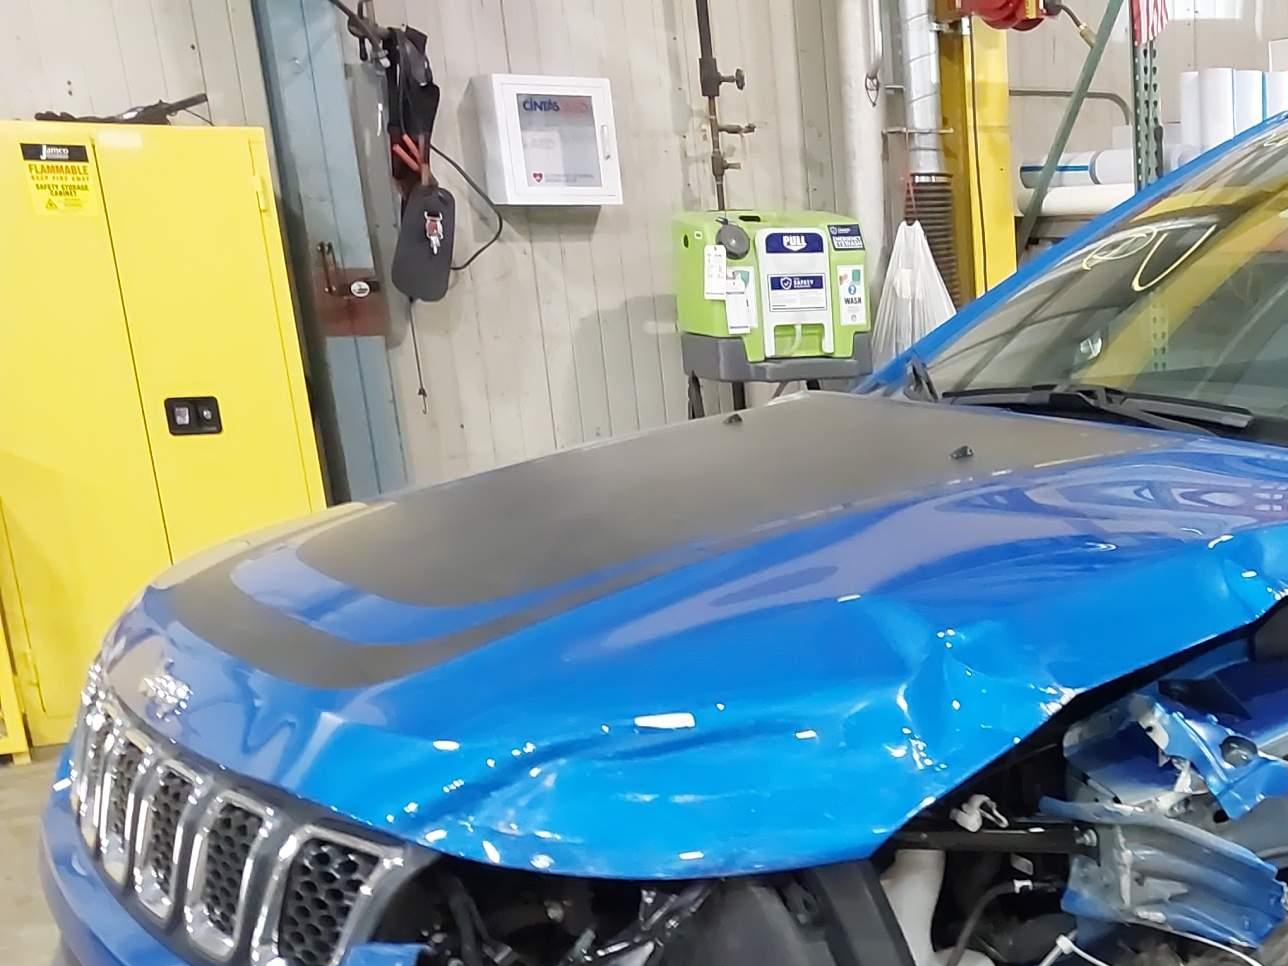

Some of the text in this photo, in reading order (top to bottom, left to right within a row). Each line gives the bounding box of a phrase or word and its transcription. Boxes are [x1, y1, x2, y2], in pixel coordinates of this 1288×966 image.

[28, 163, 89, 176] FLAMMABLE
[35, 183, 89, 192] SAFETY STORAGE
[782, 235, 807, 247] PULL
[844, 297, 862, 305] WASH
